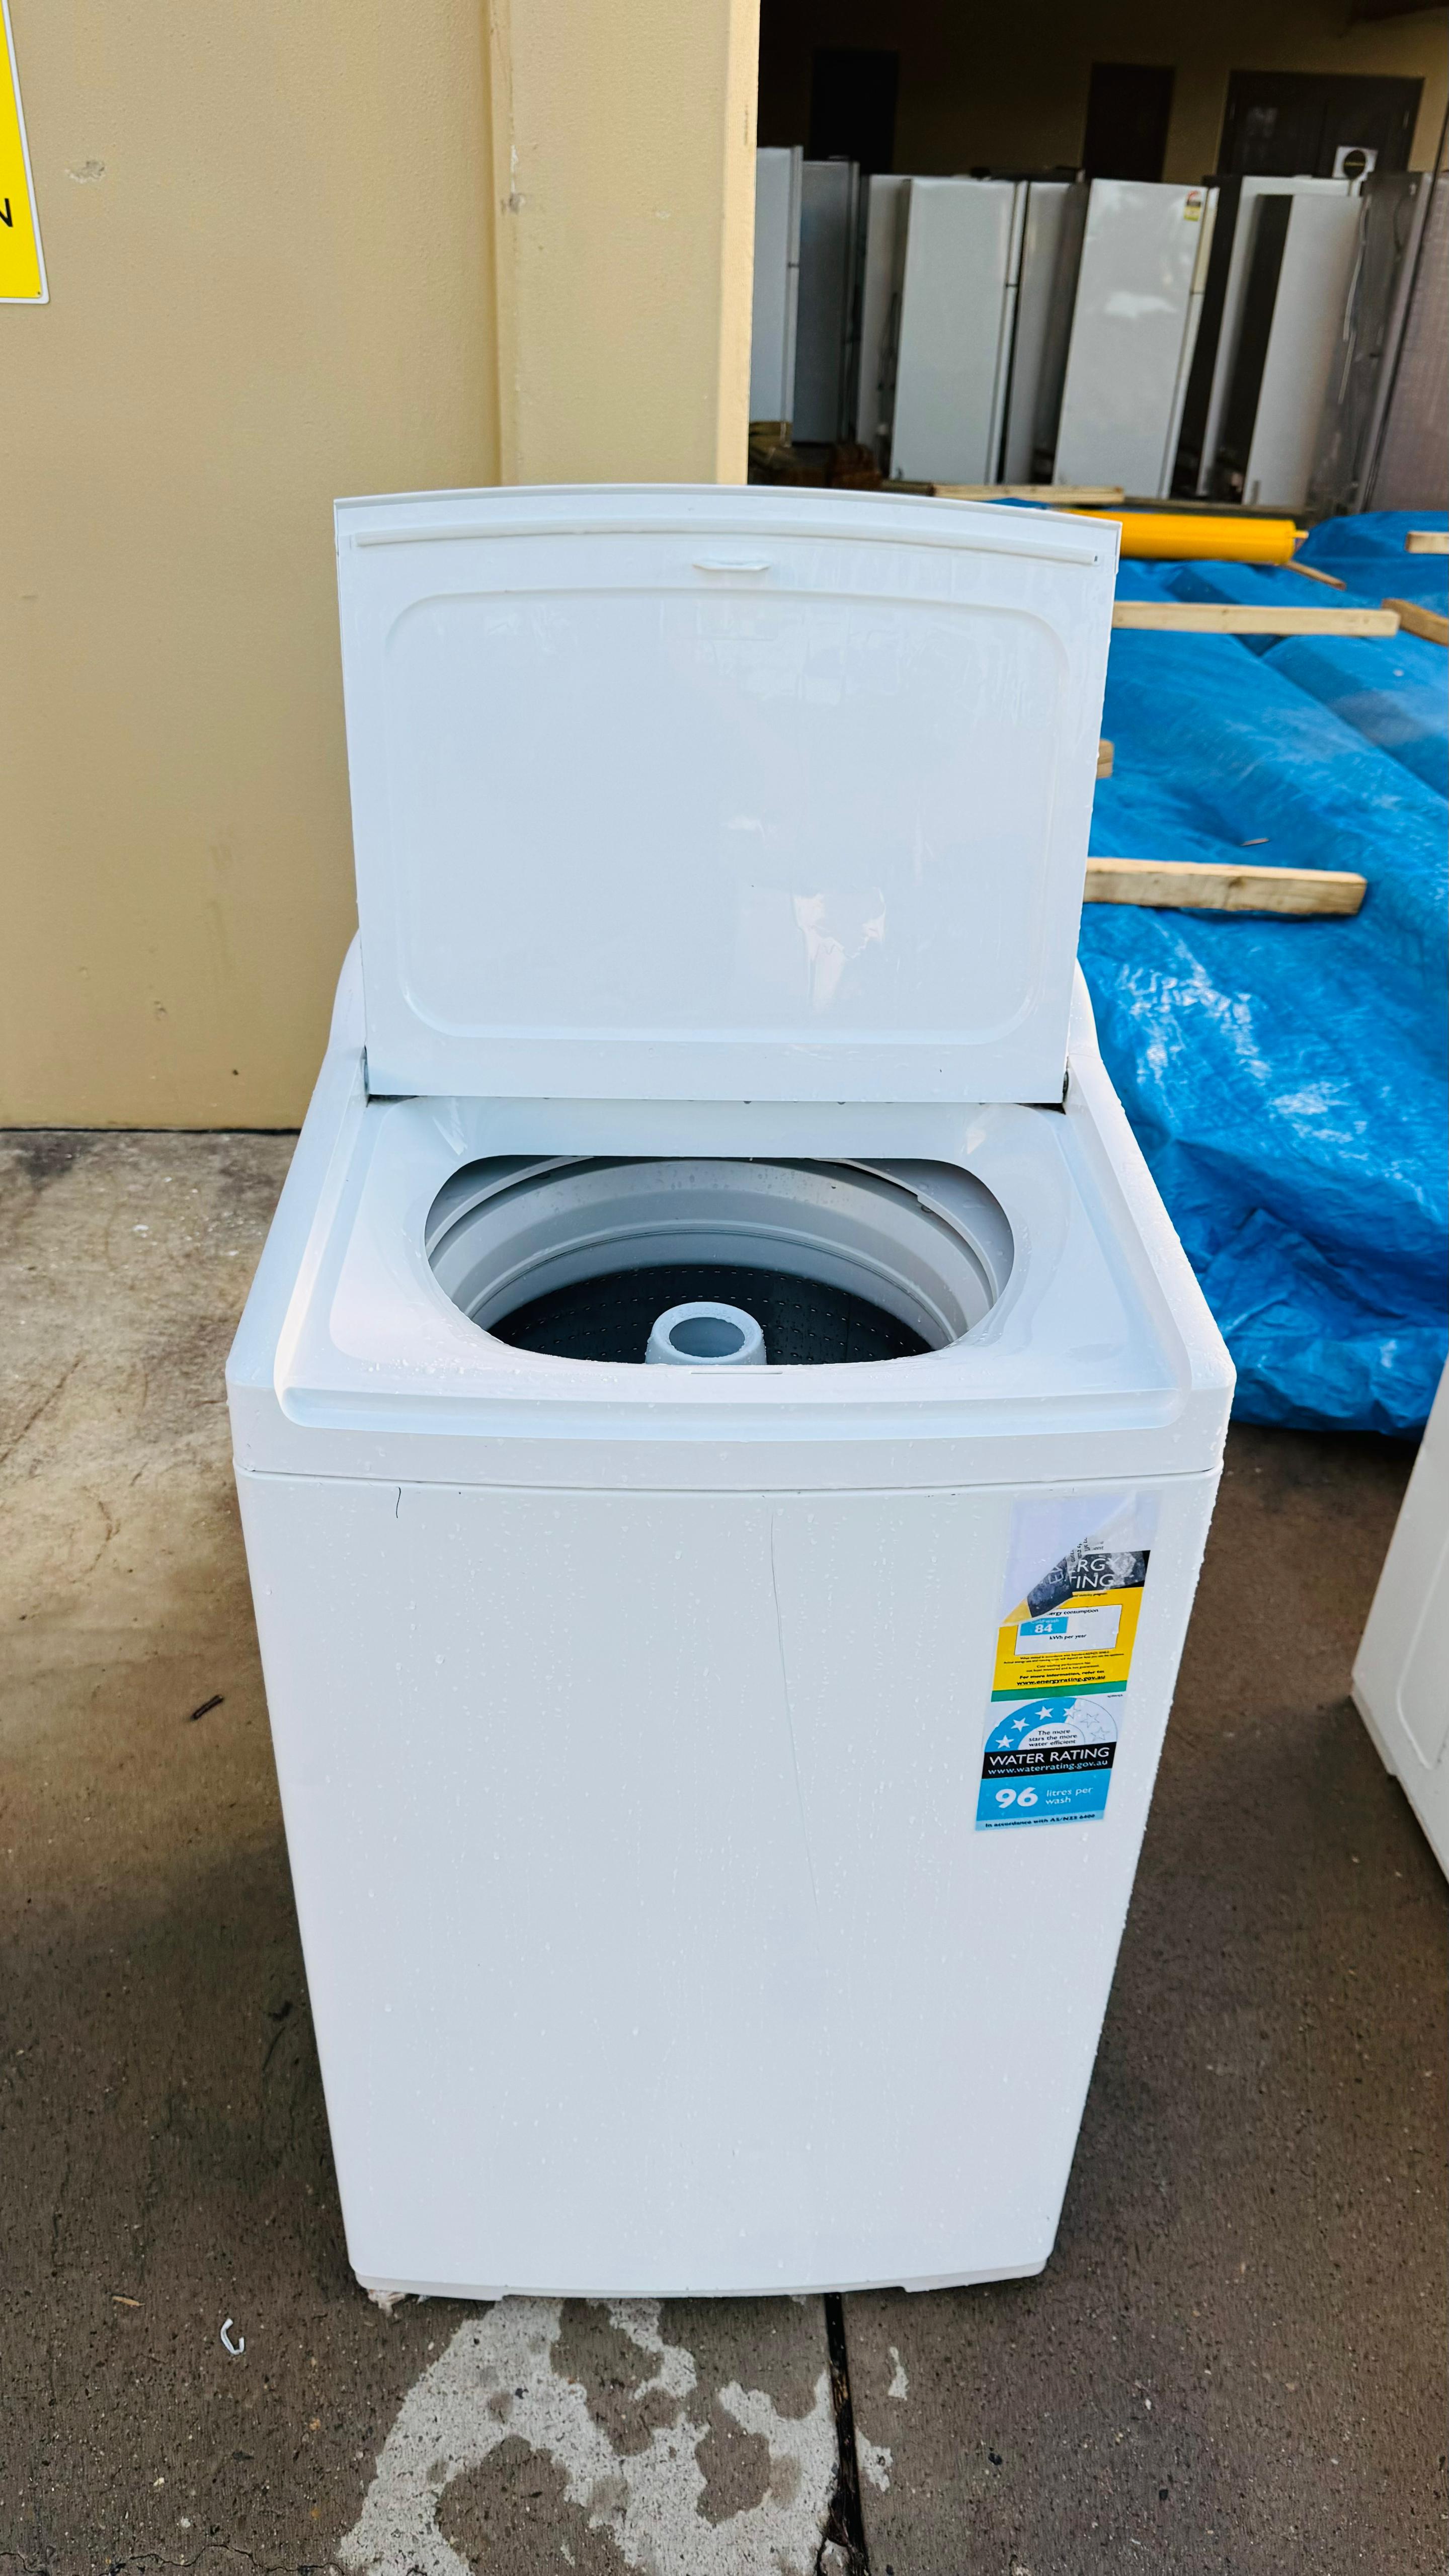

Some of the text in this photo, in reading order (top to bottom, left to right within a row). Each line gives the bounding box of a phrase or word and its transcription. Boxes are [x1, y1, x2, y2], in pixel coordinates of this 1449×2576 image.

[1034, 1624, 1053, 1634] 84
[1017, 1676, 1105, 1685] www.energyrating.gov.au
[990, 1747, 1110, 1765] WATER RATING
[988, 1760, 1107, 1775] www.waterrating.gov.au
[995, 1787, 1038, 1808] 96
[1075, 1787, 1094, 1796] per
[1045, 1797, 1071, 1805] wash
